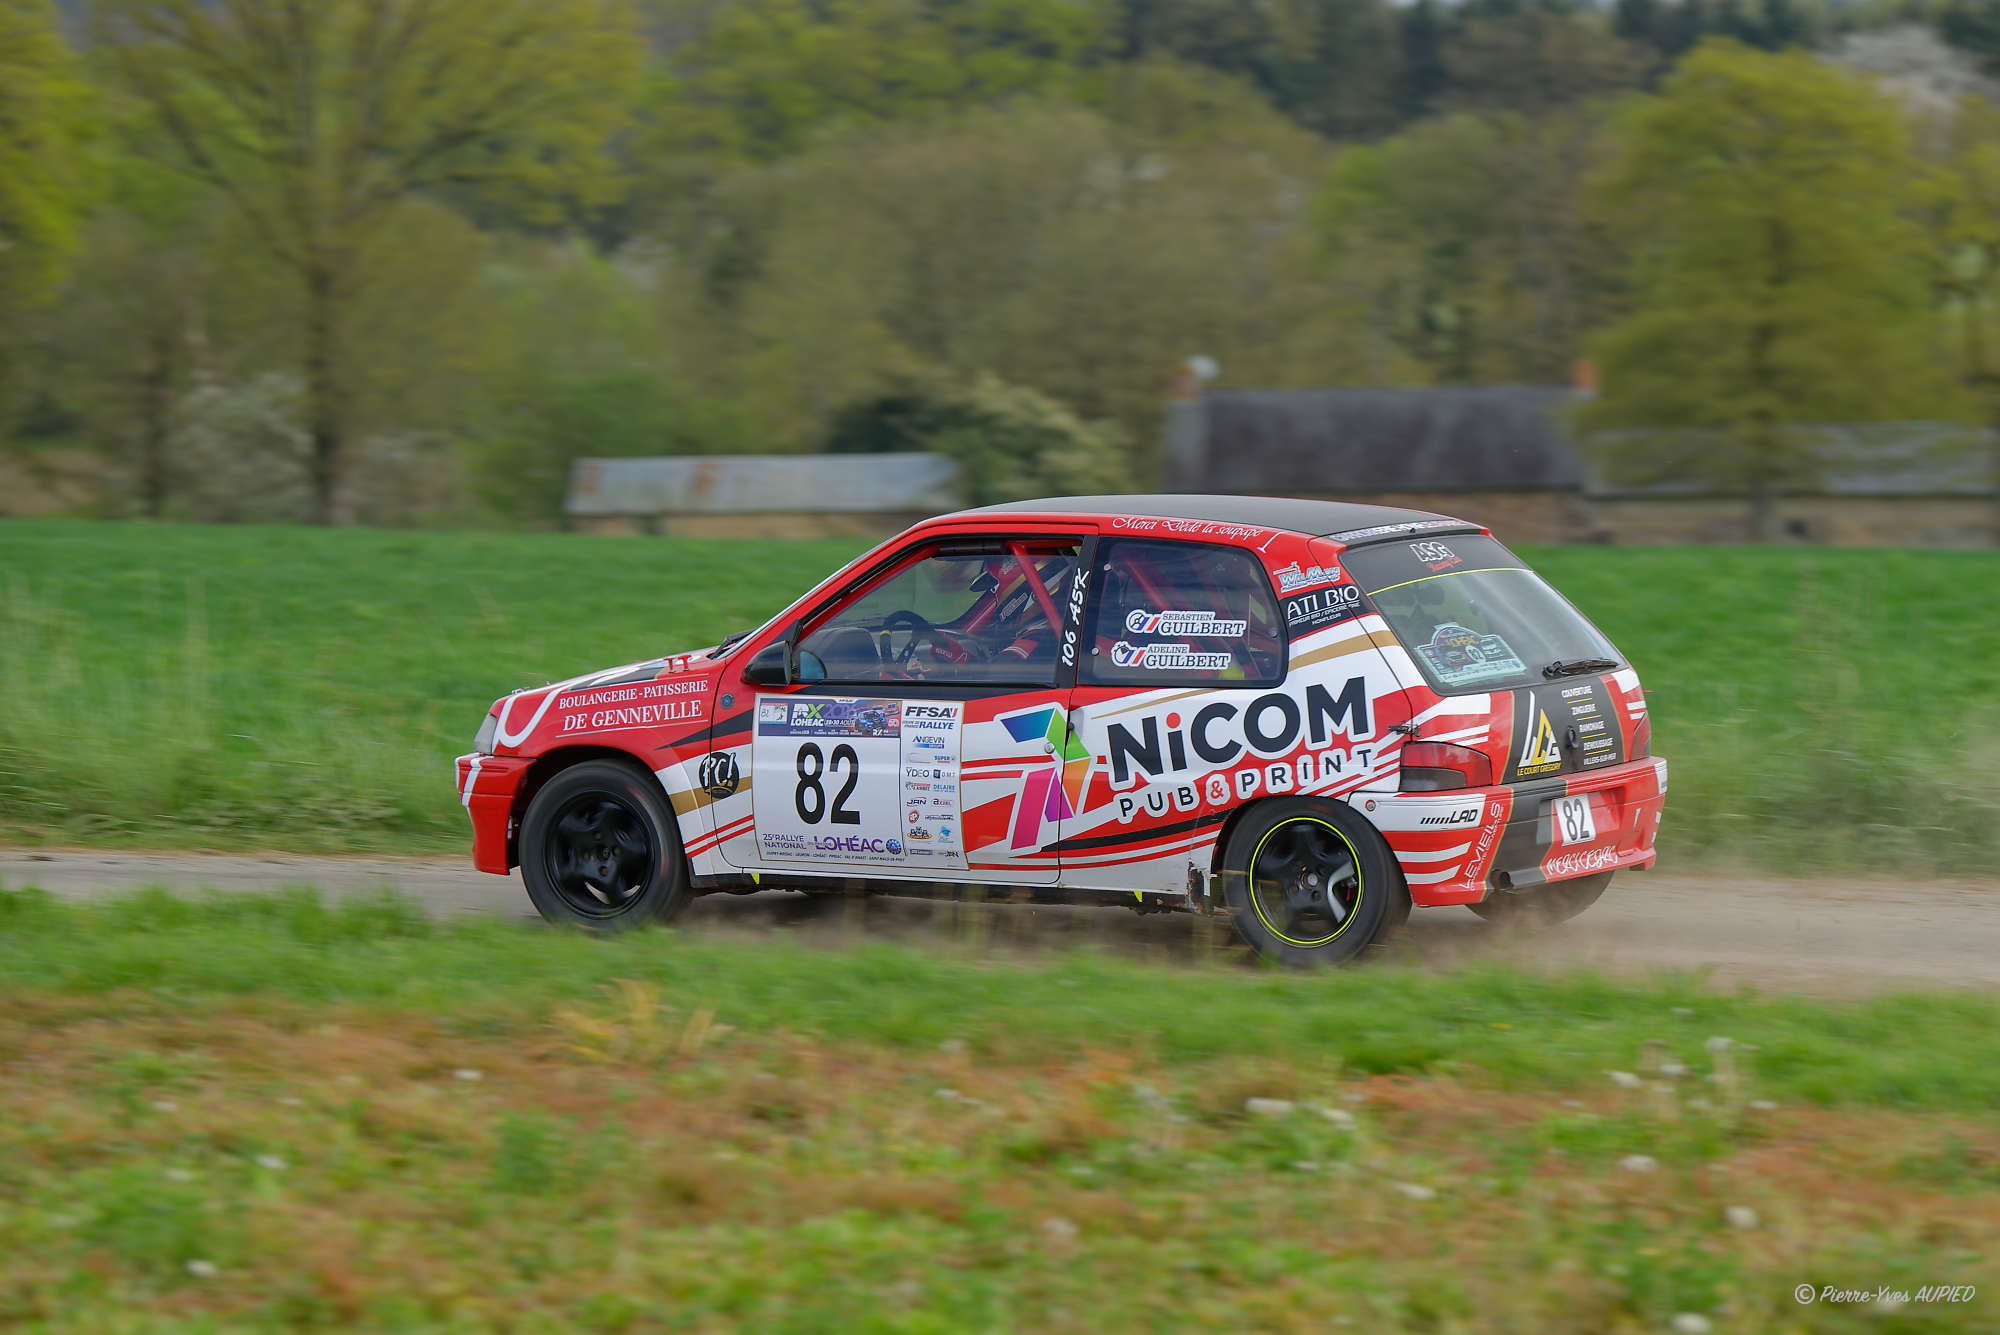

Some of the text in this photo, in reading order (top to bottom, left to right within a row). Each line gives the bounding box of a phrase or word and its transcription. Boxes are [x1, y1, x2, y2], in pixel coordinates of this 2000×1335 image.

[1112, 517, 1158, 530] Merci
[1201, 522, 1217, 535] la
[1215, 526, 1264, 541] soupape
[1287, 594, 1319, 620] ATI
[1324, 585, 1360, 607] BIO
[1061, 567, 1090, 667] 106 ASK
[1162, 613, 1214, 621] SEBASTIEN
[1160, 621, 1244, 635] GUILBERT
[1147, 645, 1188, 654] ADELINE
[1146, 654, 1229, 668] GUILBERT
[563, 699, 703, 732] DE GENNEVILLE
[905, 706, 951, 719] FFSA
[790, 718, 825, 728] LOHEAC
[919, 721, 955, 730] RALLYE
[912, 735, 945, 744] ANGEVIN
[1517, 767, 1524, 777] LE
[795, 742, 861, 825] 82
[1449, 809, 1478, 824] LAD
[1562, 798, 1590, 841] 82
[764, 841, 807, 850] NATIONAL
[774, 834, 805, 843] RALLYE
[813, 835, 885, 854] LOHÉAC
